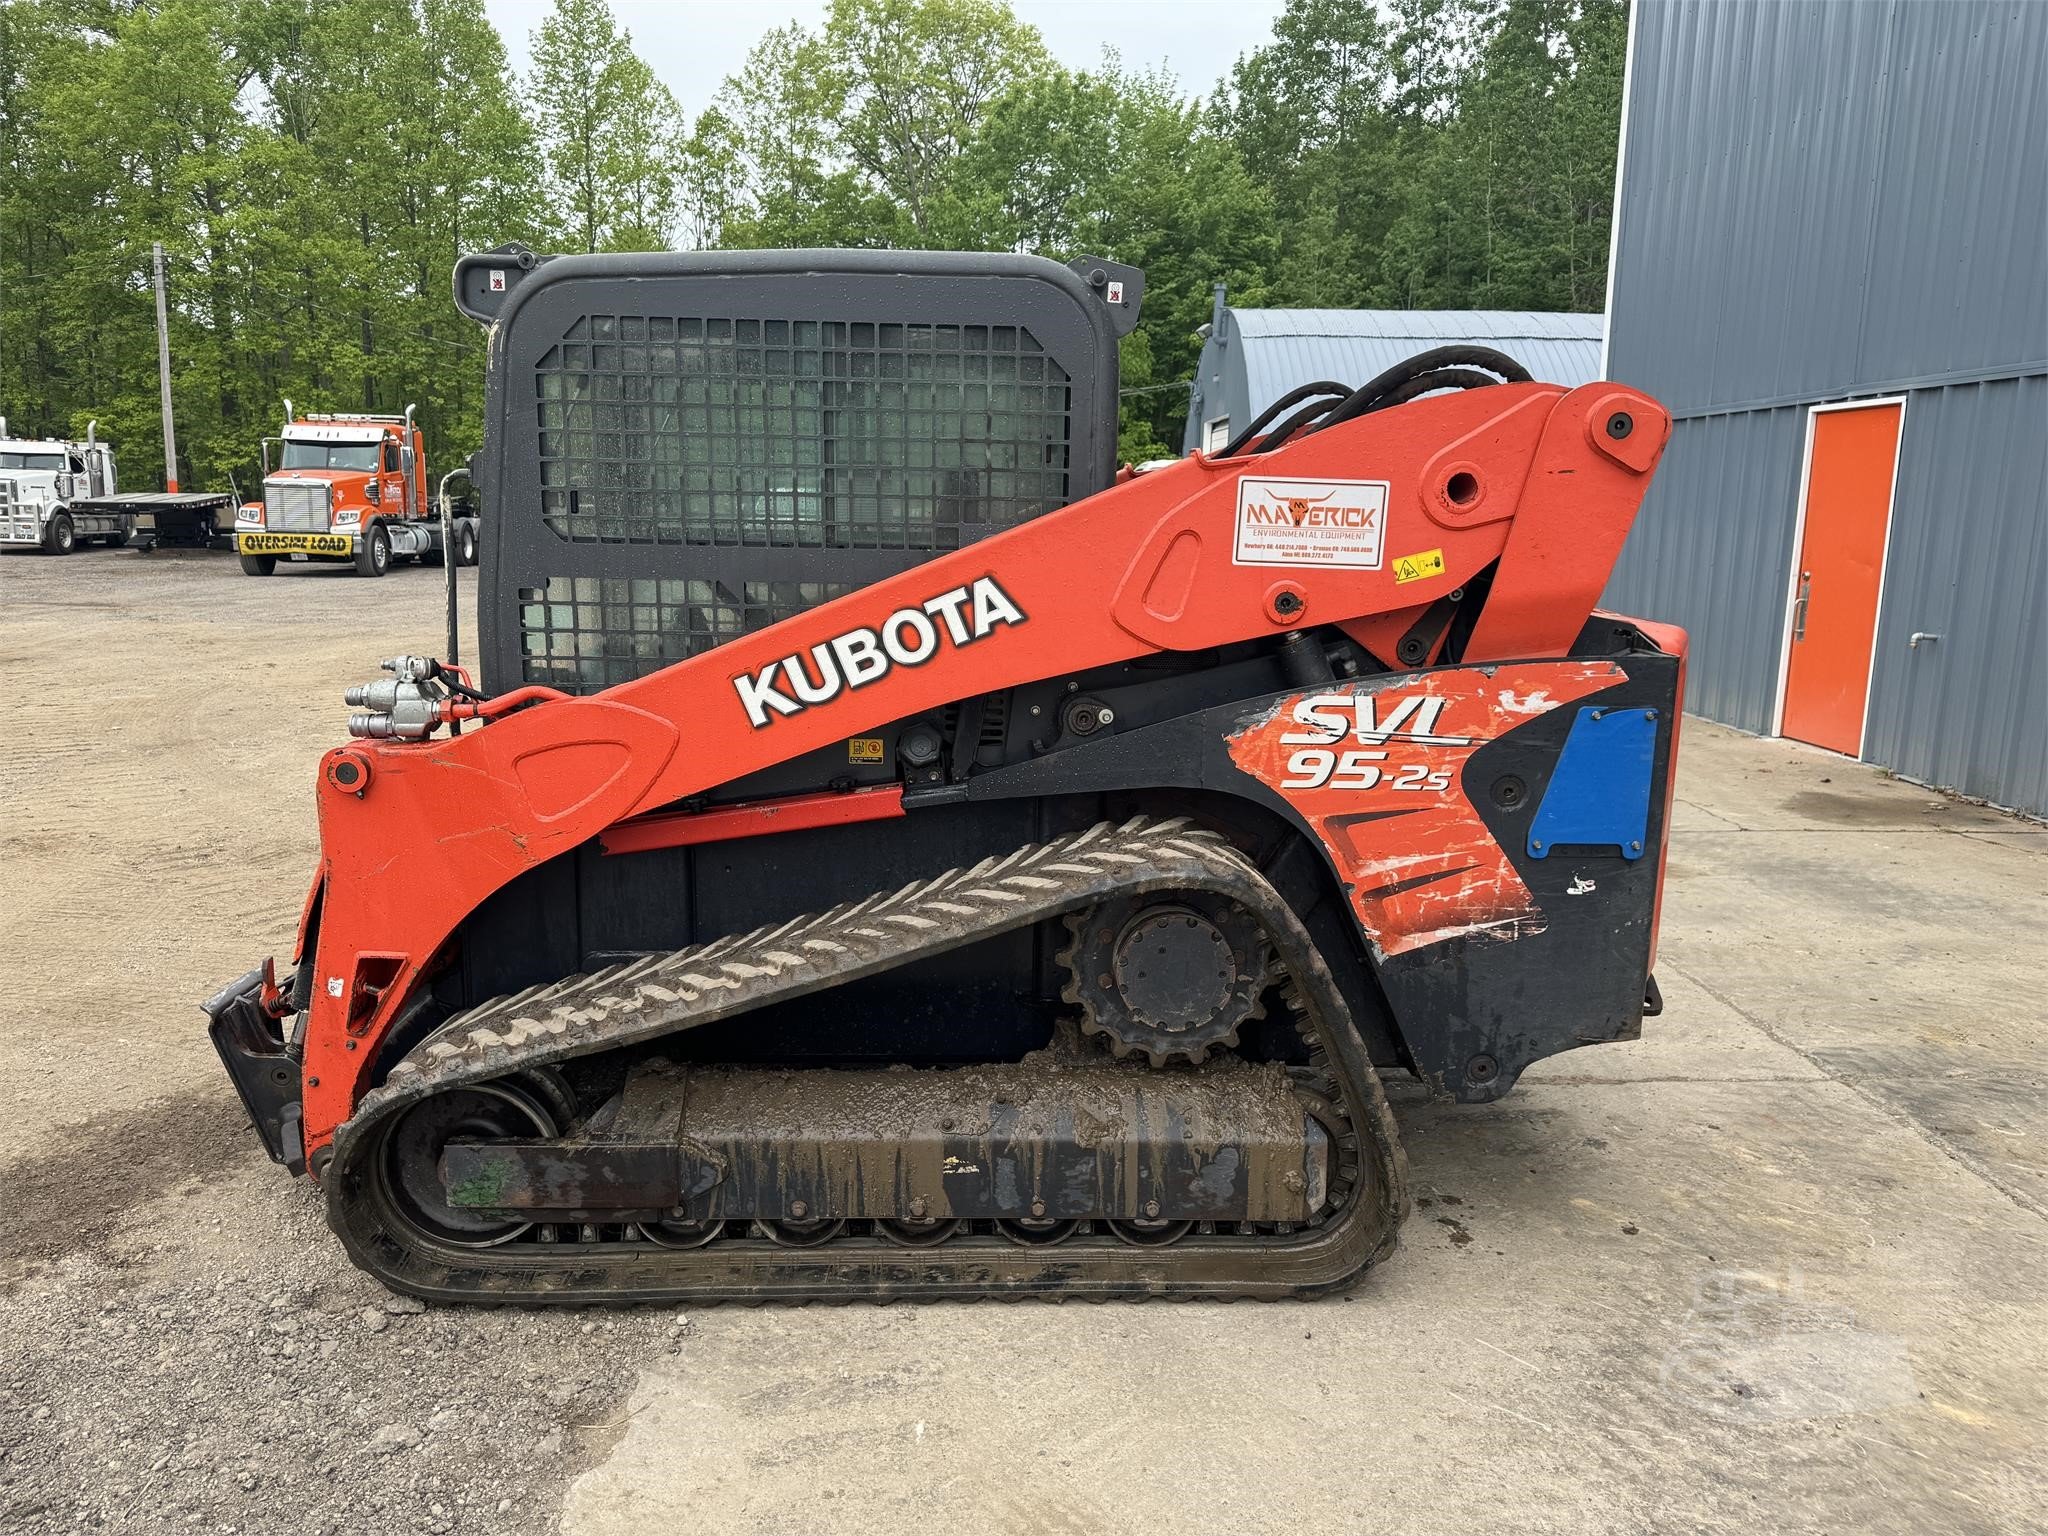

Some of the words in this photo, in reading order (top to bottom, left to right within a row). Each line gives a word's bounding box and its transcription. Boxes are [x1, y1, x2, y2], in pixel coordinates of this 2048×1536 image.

[1246, 502, 1377, 528] MAVERICK
[244, 535, 308, 550] OVERSIZE
[310, 536, 347, 552] LOAD
[1253, 529, 1319, 539] ENVIRONMENTAL
[1321, 531, 1367, 540] EQUIPMENT
[733, 577, 1026, 728] KUBOTA
[1279, 695, 1473, 746] SVL
